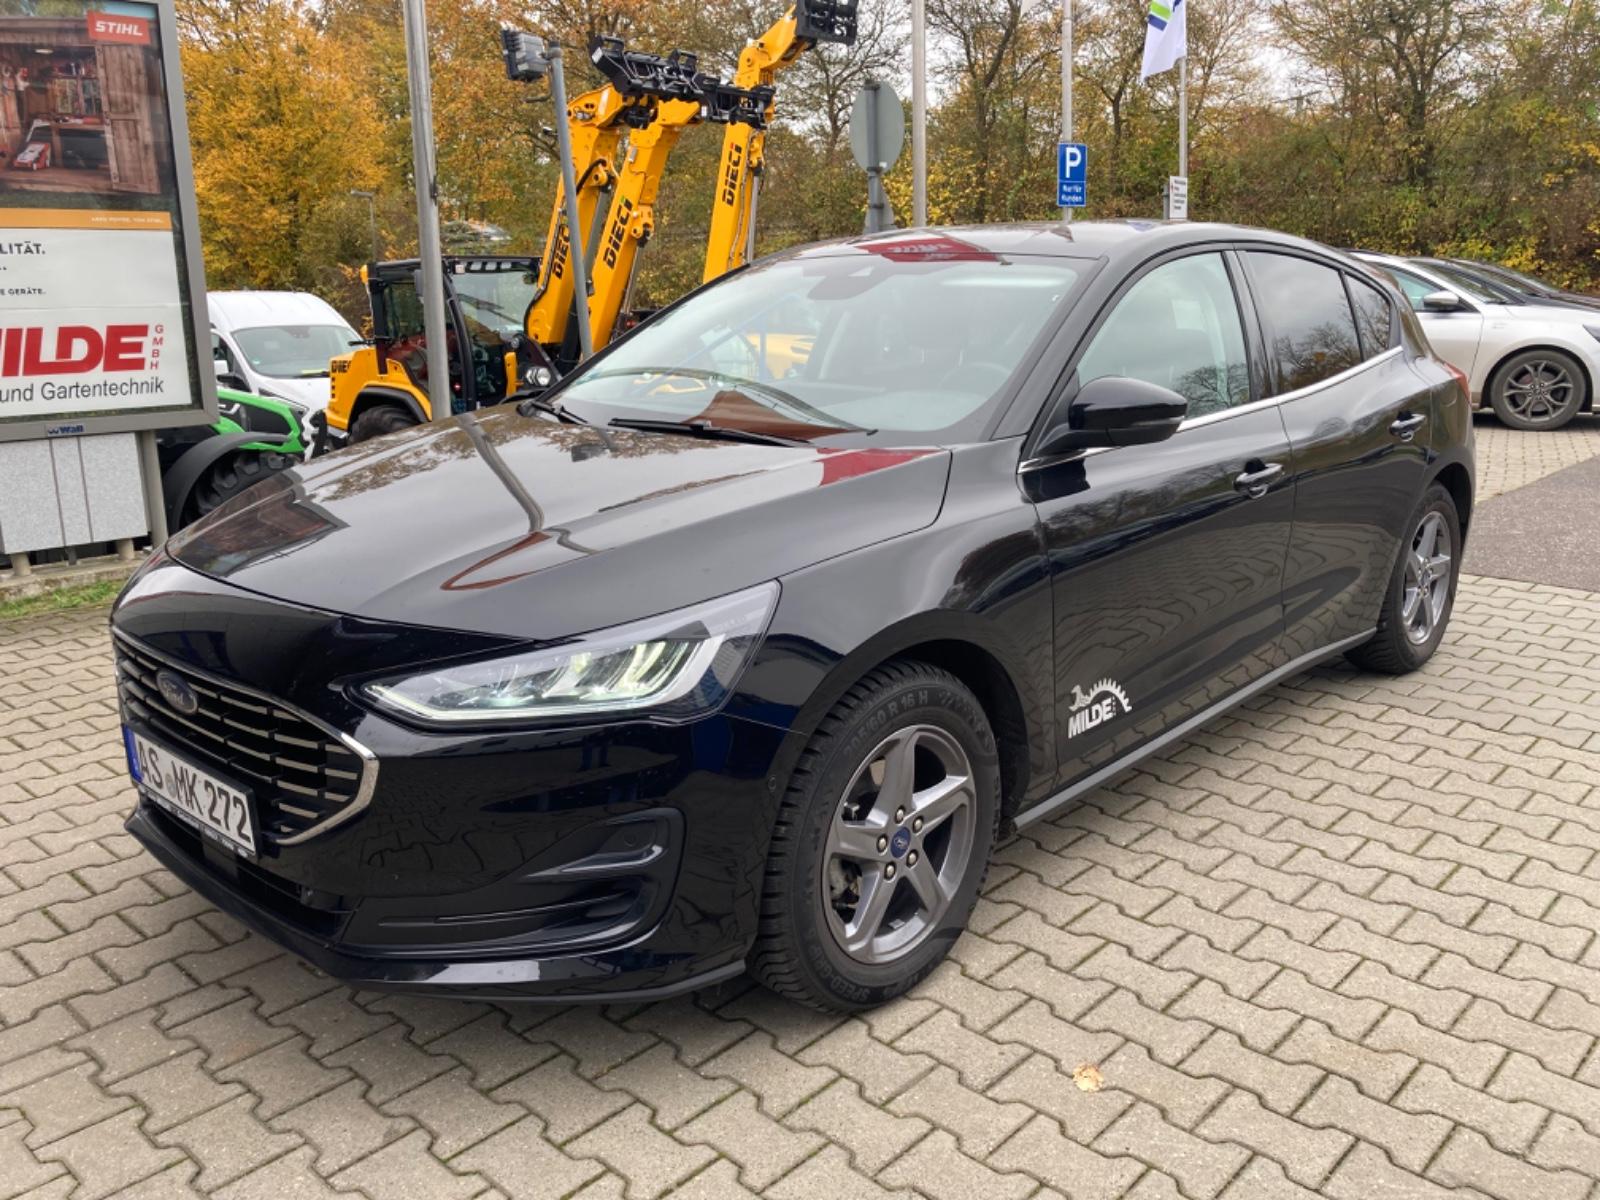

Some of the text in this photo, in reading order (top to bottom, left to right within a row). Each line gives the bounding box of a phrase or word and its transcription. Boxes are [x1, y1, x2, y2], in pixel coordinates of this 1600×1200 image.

[95, 20, 143, 36] STIHL
[722, 142, 742, 207] DIECI
[1065, 147, 1081, 178] P
[552, 224, 570, 279] DIEC
[603, 195, 633, 269] DIECI
[0, 324, 149, 378] ILDE
[41, 378, 164, 400] Gartentechnik
[1068, 697, 1113, 739] MILDE
[138, 740, 163, 790] AS
[171, 760, 204, 816] MK
[204, 779, 252, 844] 272
